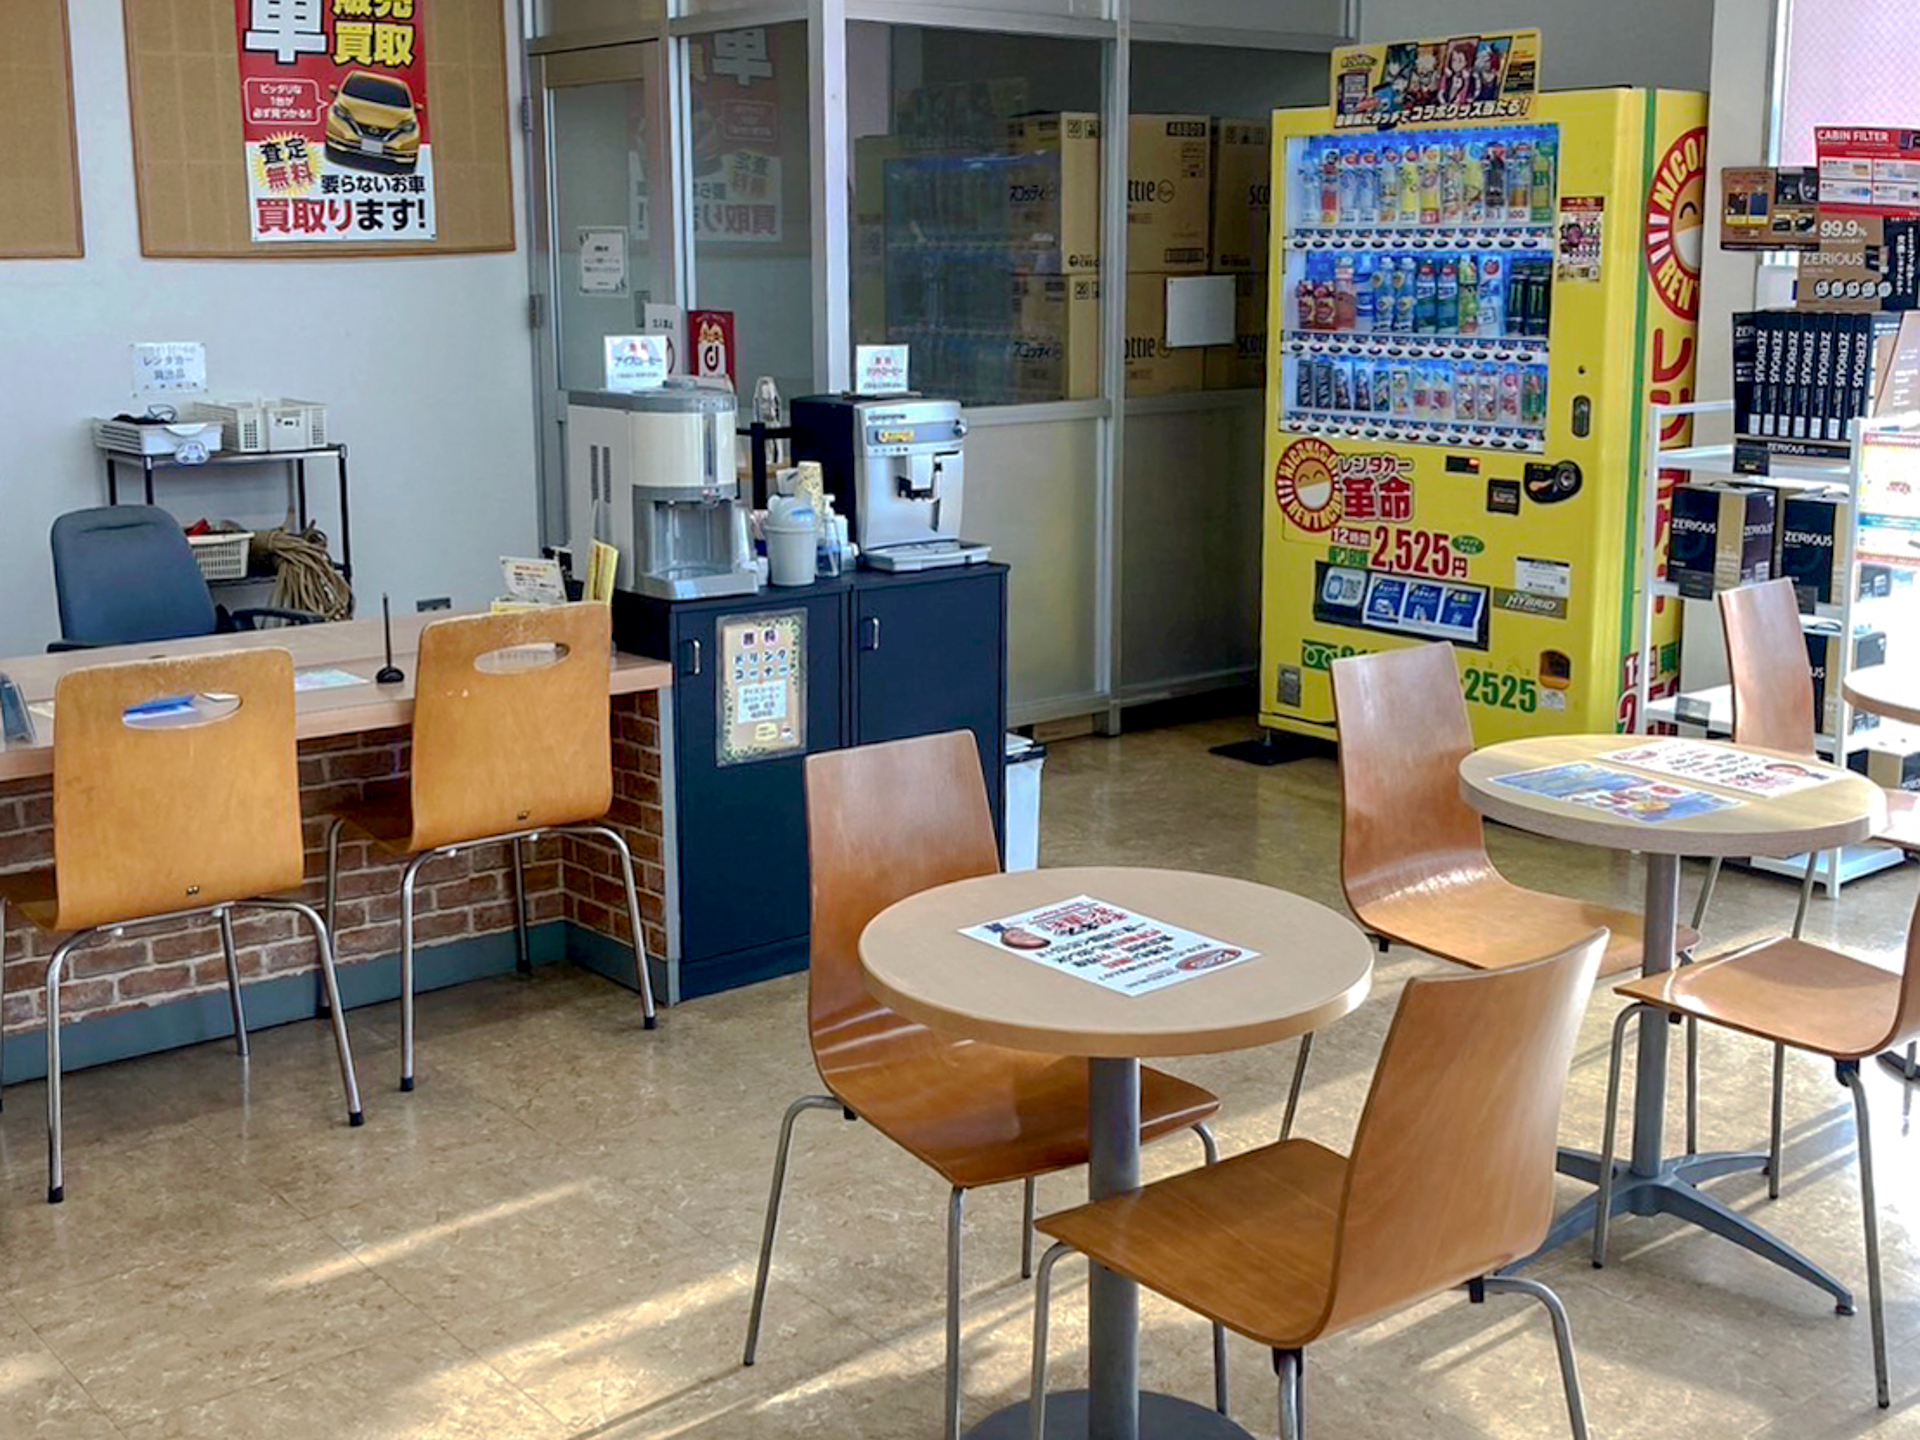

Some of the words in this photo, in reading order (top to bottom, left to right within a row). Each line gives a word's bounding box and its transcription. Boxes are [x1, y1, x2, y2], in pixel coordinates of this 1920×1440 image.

[245, 0, 327, 64] 車
[333, 21, 414, 66] 買取
[259, 139, 308, 165] 査定
[1817, 129, 1851, 142] CABIN
[1853, 130, 1889, 142] FILTER
[266, 162, 315, 189] 無料
[321, 175, 426, 194] 要らないお車
[1653, 136, 1706, 208] NICO
[256, 199, 426, 233] 買取ります!
[1802, 252, 1864, 266] ZERIOUS
[1755, 329, 1767, 383] ZERIOUS
[1769, 330, 1783, 384] ZERIOUS
[1785, 330, 1799, 385] ZERIOUS
[1800, 331, 1815, 386] ZERIOUS
[1817, 331, 1832, 387] ZERIOUS
[1835, 332, 1850, 388] ZERIOUS
[1852, 332, 1867, 389] ZERIOUS
[1340, 457, 1411, 474] レンタカー
[1343, 475, 1411, 519] 革命
[1672, 518, 1716, 534] ZERIOUS
[1784, 531, 1833, 547] ZERIOUS
